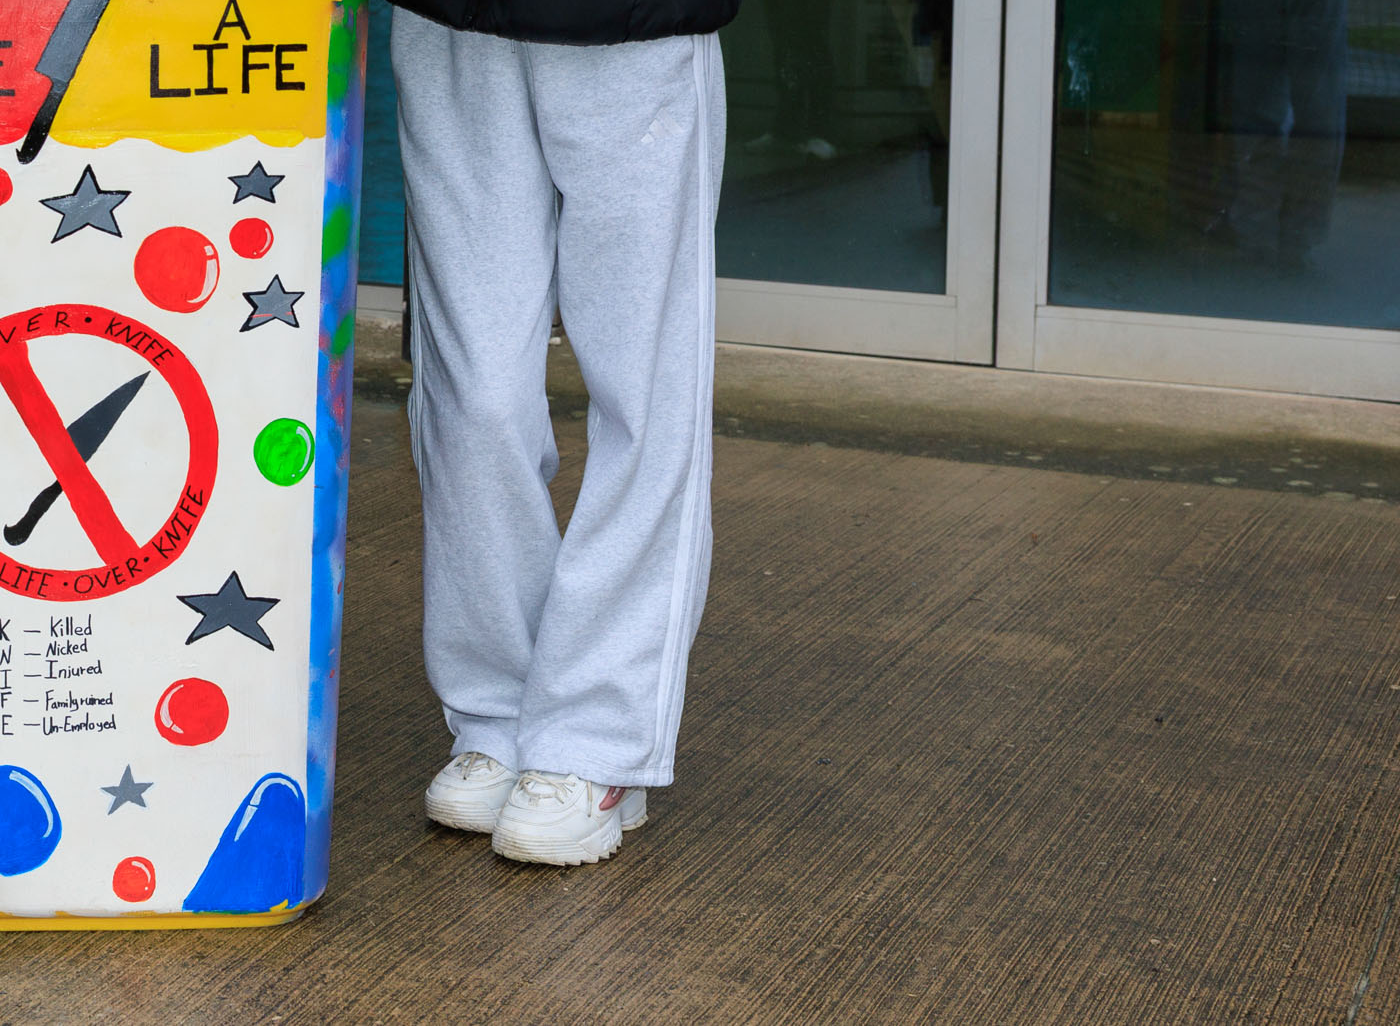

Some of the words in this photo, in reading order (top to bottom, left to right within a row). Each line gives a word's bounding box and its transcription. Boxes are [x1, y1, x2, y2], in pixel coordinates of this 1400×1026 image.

[150, 43, 307, 99] LIFE
[104, 317, 174, 367] KNIFE
[73, 557, 142, 594] OVER
[152, 485, 204, 559] KNIFE
[50, 614, 93, 638] Killed
[0, 644, 12, 666] N
[46, 638, 88, 657] Nicked
[0, 669, 12, 689] I
[44, 659, 103, 679] Injured
[0, 691, 12, 709] F
[2, 714, 14, 736] E
